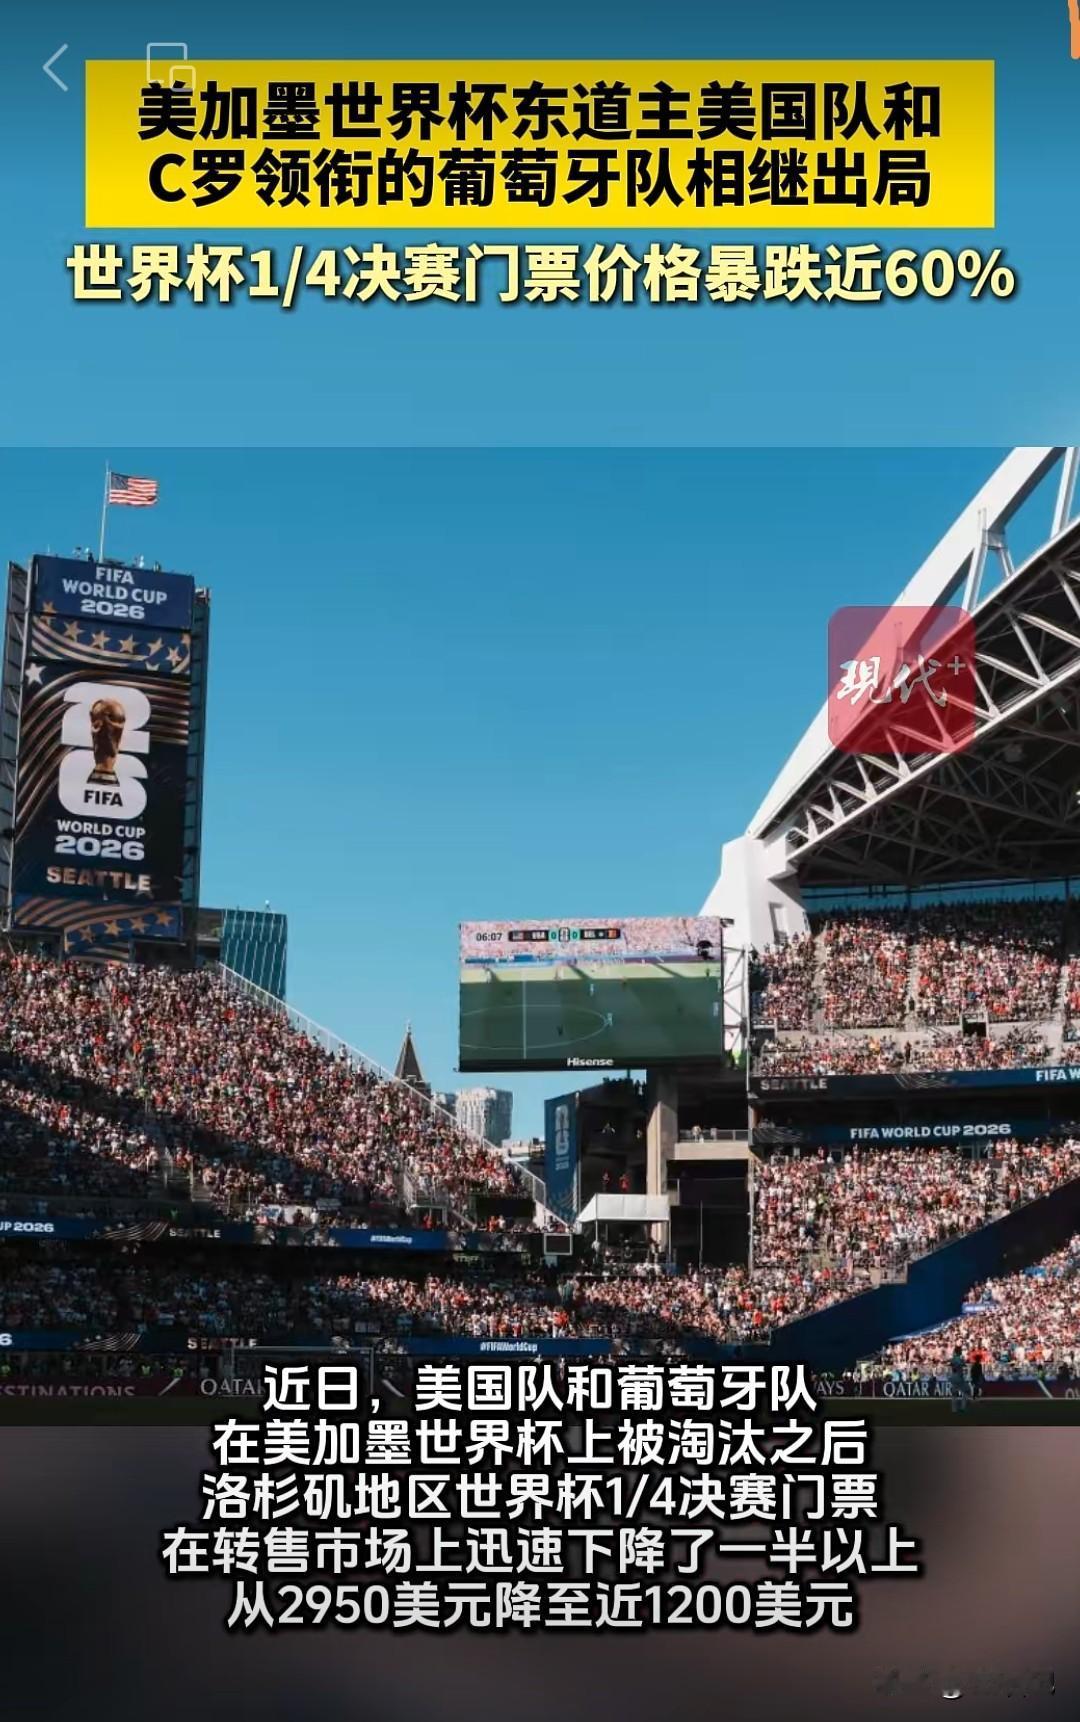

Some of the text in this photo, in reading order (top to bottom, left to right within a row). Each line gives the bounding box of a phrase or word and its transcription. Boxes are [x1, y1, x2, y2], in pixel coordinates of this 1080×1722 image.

[96, 566, 135, 585] FIFA
[62, 579, 168, 604] WORLD CUP
[80, 599, 145, 620] 2026
[83, 789, 123, 808] FIFA
[57, 819, 146, 839] WORLD CUP
[55, 835, 145, 861] 2026
[47, 866, 151, 892] SEATTLE
[476, 932, 502, 942] 06:07
[567, 1056, 614, 1067] Hisense
[1035, 1068, 1067, 1082] FIFA
[760, 1078, 828, 1091] SEATTLE
[850, 1124, 1011, 1139] FIFA WORLD CUP 2026
[14, 1221, 54, 1233] 2026
[169, 1227, 221, 1238] SEATTLE
[0, 1385, 135, 1396] STINATIONS
[883, 1381, 929, 1397] QATAR
